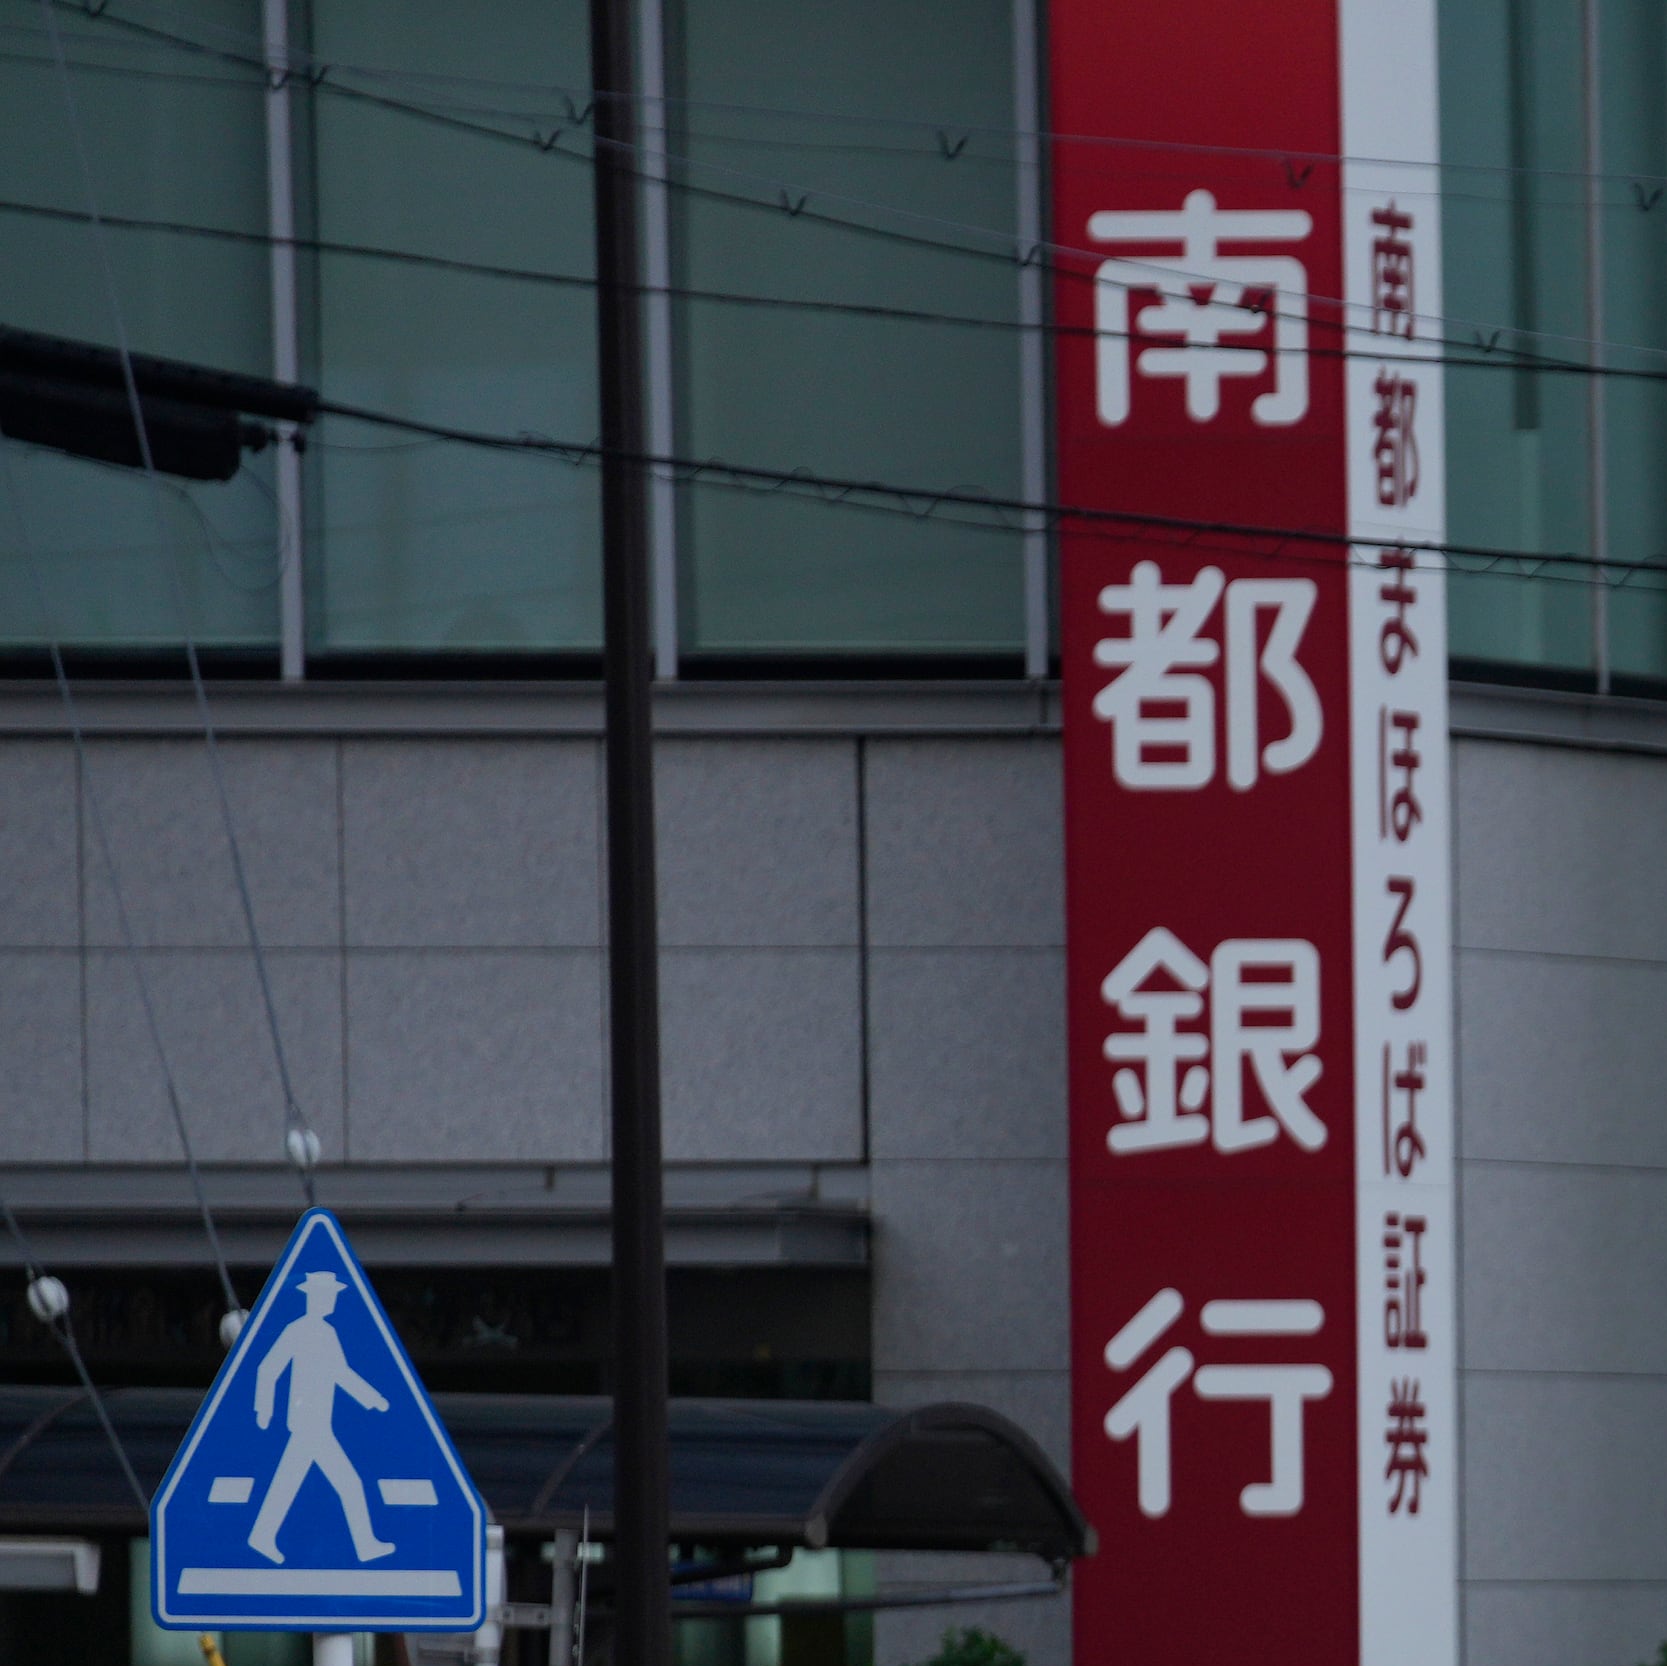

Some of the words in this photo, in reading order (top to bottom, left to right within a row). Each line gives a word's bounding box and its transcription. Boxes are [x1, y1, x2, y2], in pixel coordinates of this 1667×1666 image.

[1086, 187, 1334, 1519] 南都銀行
[1370, 200, 1429, 1519] 南都まほろば証券
